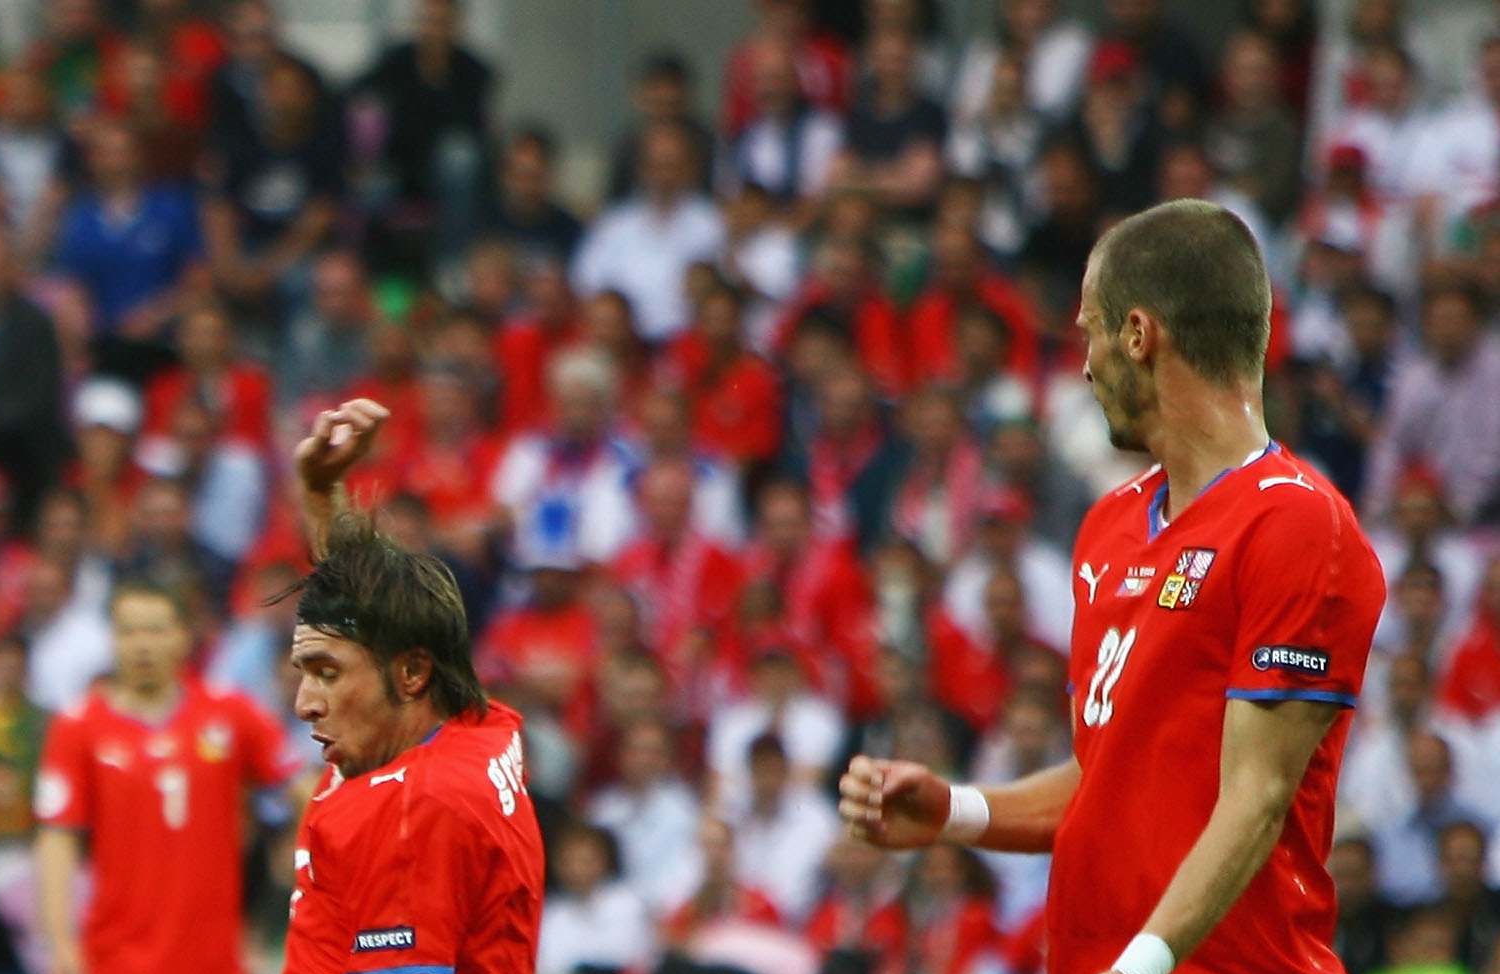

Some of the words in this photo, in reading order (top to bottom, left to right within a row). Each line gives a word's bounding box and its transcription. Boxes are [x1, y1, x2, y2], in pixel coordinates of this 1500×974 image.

[1271, 650, 1327, 671] RESPECT
[1083, 625, 1137, 728] 22
[357, 931, 413, 949] RESPECT
